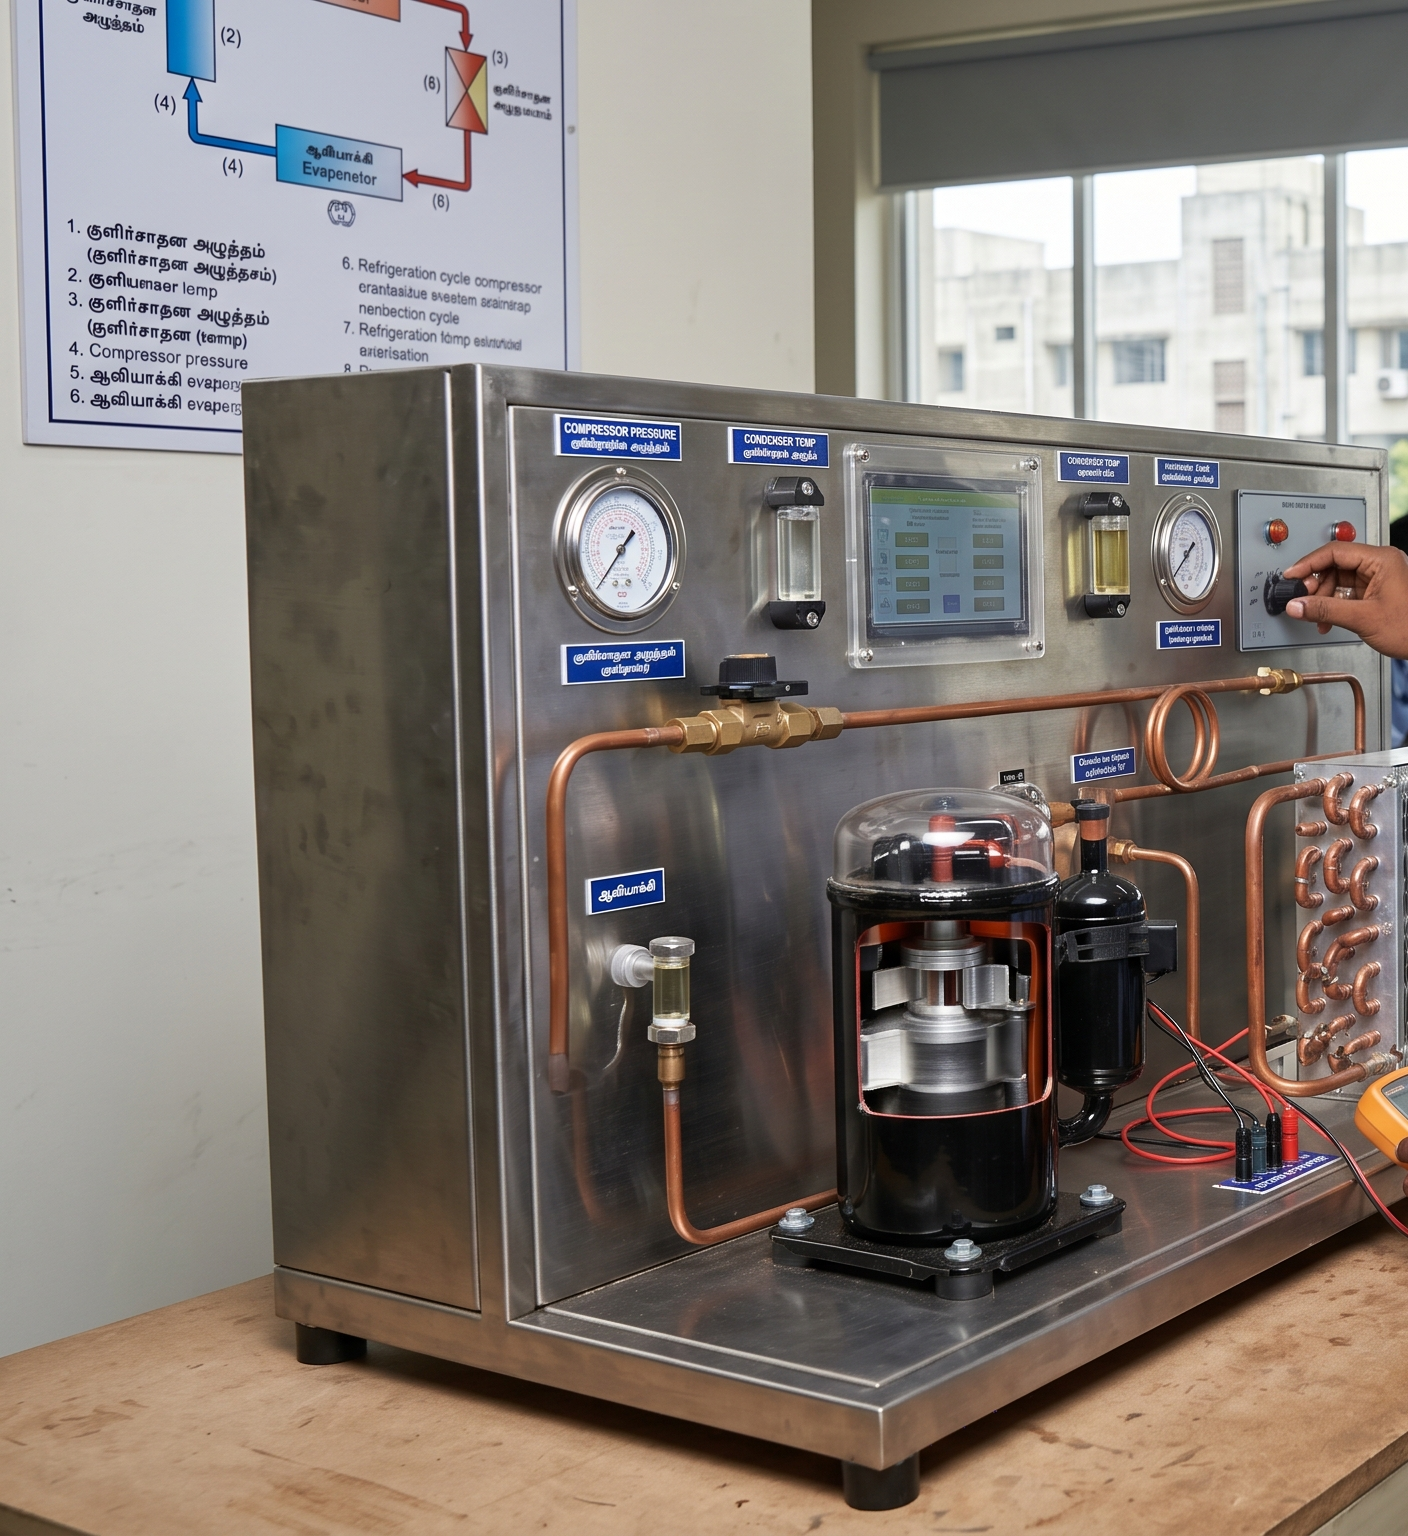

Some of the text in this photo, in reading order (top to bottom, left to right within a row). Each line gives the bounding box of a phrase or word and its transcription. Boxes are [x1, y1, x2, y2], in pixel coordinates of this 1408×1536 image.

[220, 26, 242, 49] (2)
[492, 49, 509, 69] (3)
[154, 93, 177, 116] (4)
[222, 156, 244, 179] (4)
[302, 161, 378, 187] Evapenetor
[67, 218, 81, 234] 1.
[87, 223, 188, 250] குளிர்சாதன
[67, 267, 82, 283] 2.
[342, 256, 354, 271] 6.
[358, 258, 437, 280] Refrigeration
[439, 271, 471, 287] cycle
[68, 292, 83, 308] 3.
[197, 307, 270, 329] அழுத்தம்
[343, 320, 355, 336] 7.
[359, 322, 437, 343] Refrigeration
[68, 341, 249, 370] 4. Compressor pressure
[70, 364, 85, 380] 5.
[90, 367, 182, 387] ஆவியாக்கி
[70, 389, 85, 404] 6.
[90, 390, 182, 410] ஆவியாக்கி
[564, 422, 629, 437] COMPRESSOR
